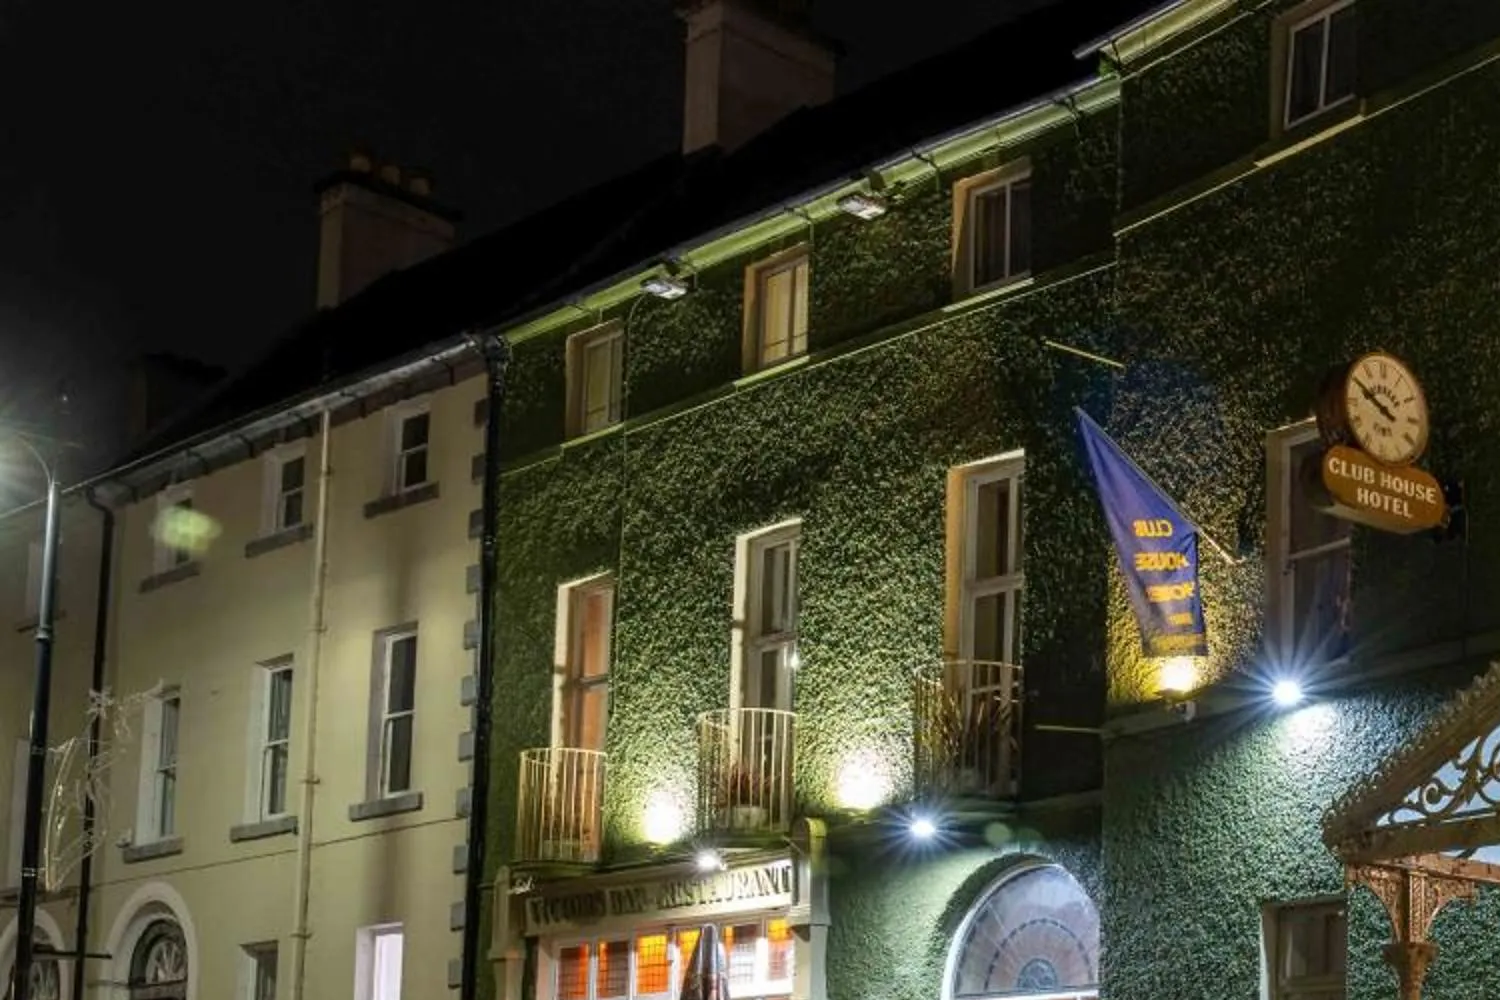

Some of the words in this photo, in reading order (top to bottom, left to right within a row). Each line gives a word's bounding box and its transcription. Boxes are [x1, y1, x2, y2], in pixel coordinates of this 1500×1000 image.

[1328, 456, 1376, 485] CLUB
[1380, 470, 1437, 505] HOUSE
[1356, 487, 1415, 519] HOTEL
[609, 887, 648, 915] BAR
[656, 866, 793, 911] RESTAURANT
